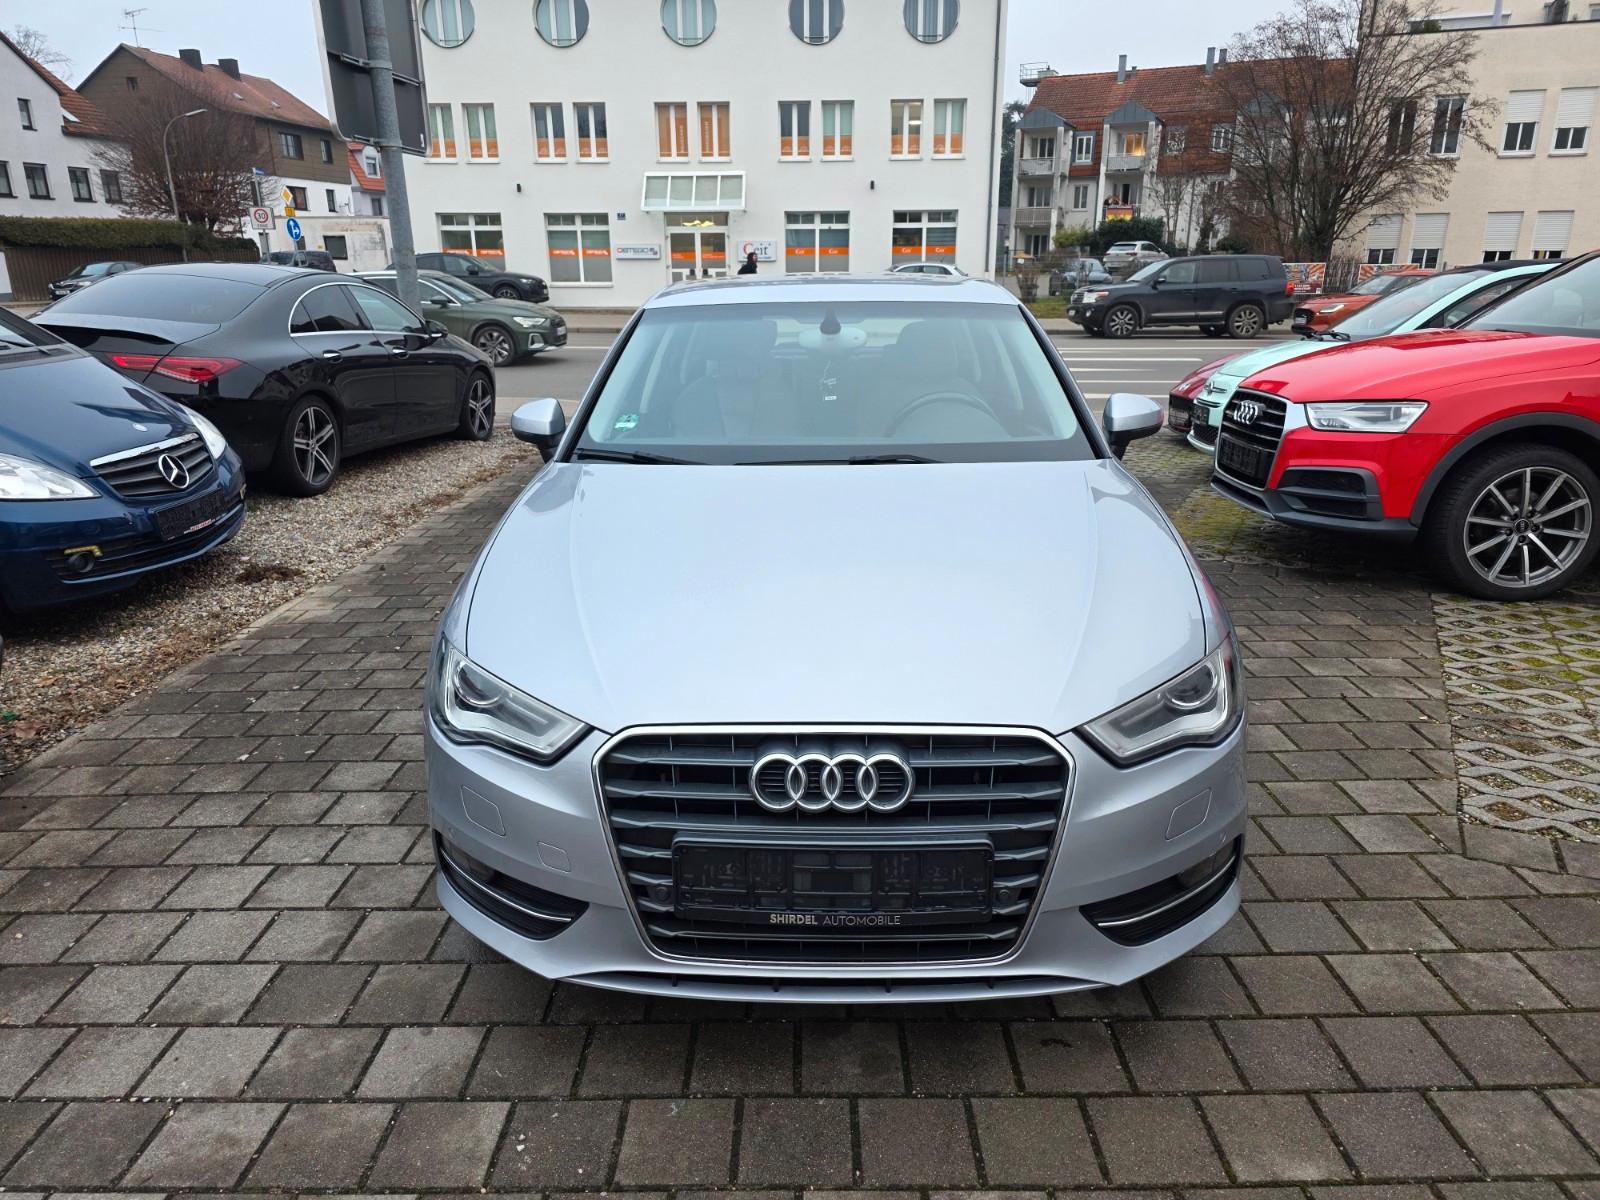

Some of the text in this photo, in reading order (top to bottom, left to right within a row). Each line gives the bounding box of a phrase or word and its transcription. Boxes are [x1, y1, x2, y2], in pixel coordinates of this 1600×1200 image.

[257, 212, 266, 220] 30
[769, 914, 901, 926] SHIRDEL AUTOMOBILE
